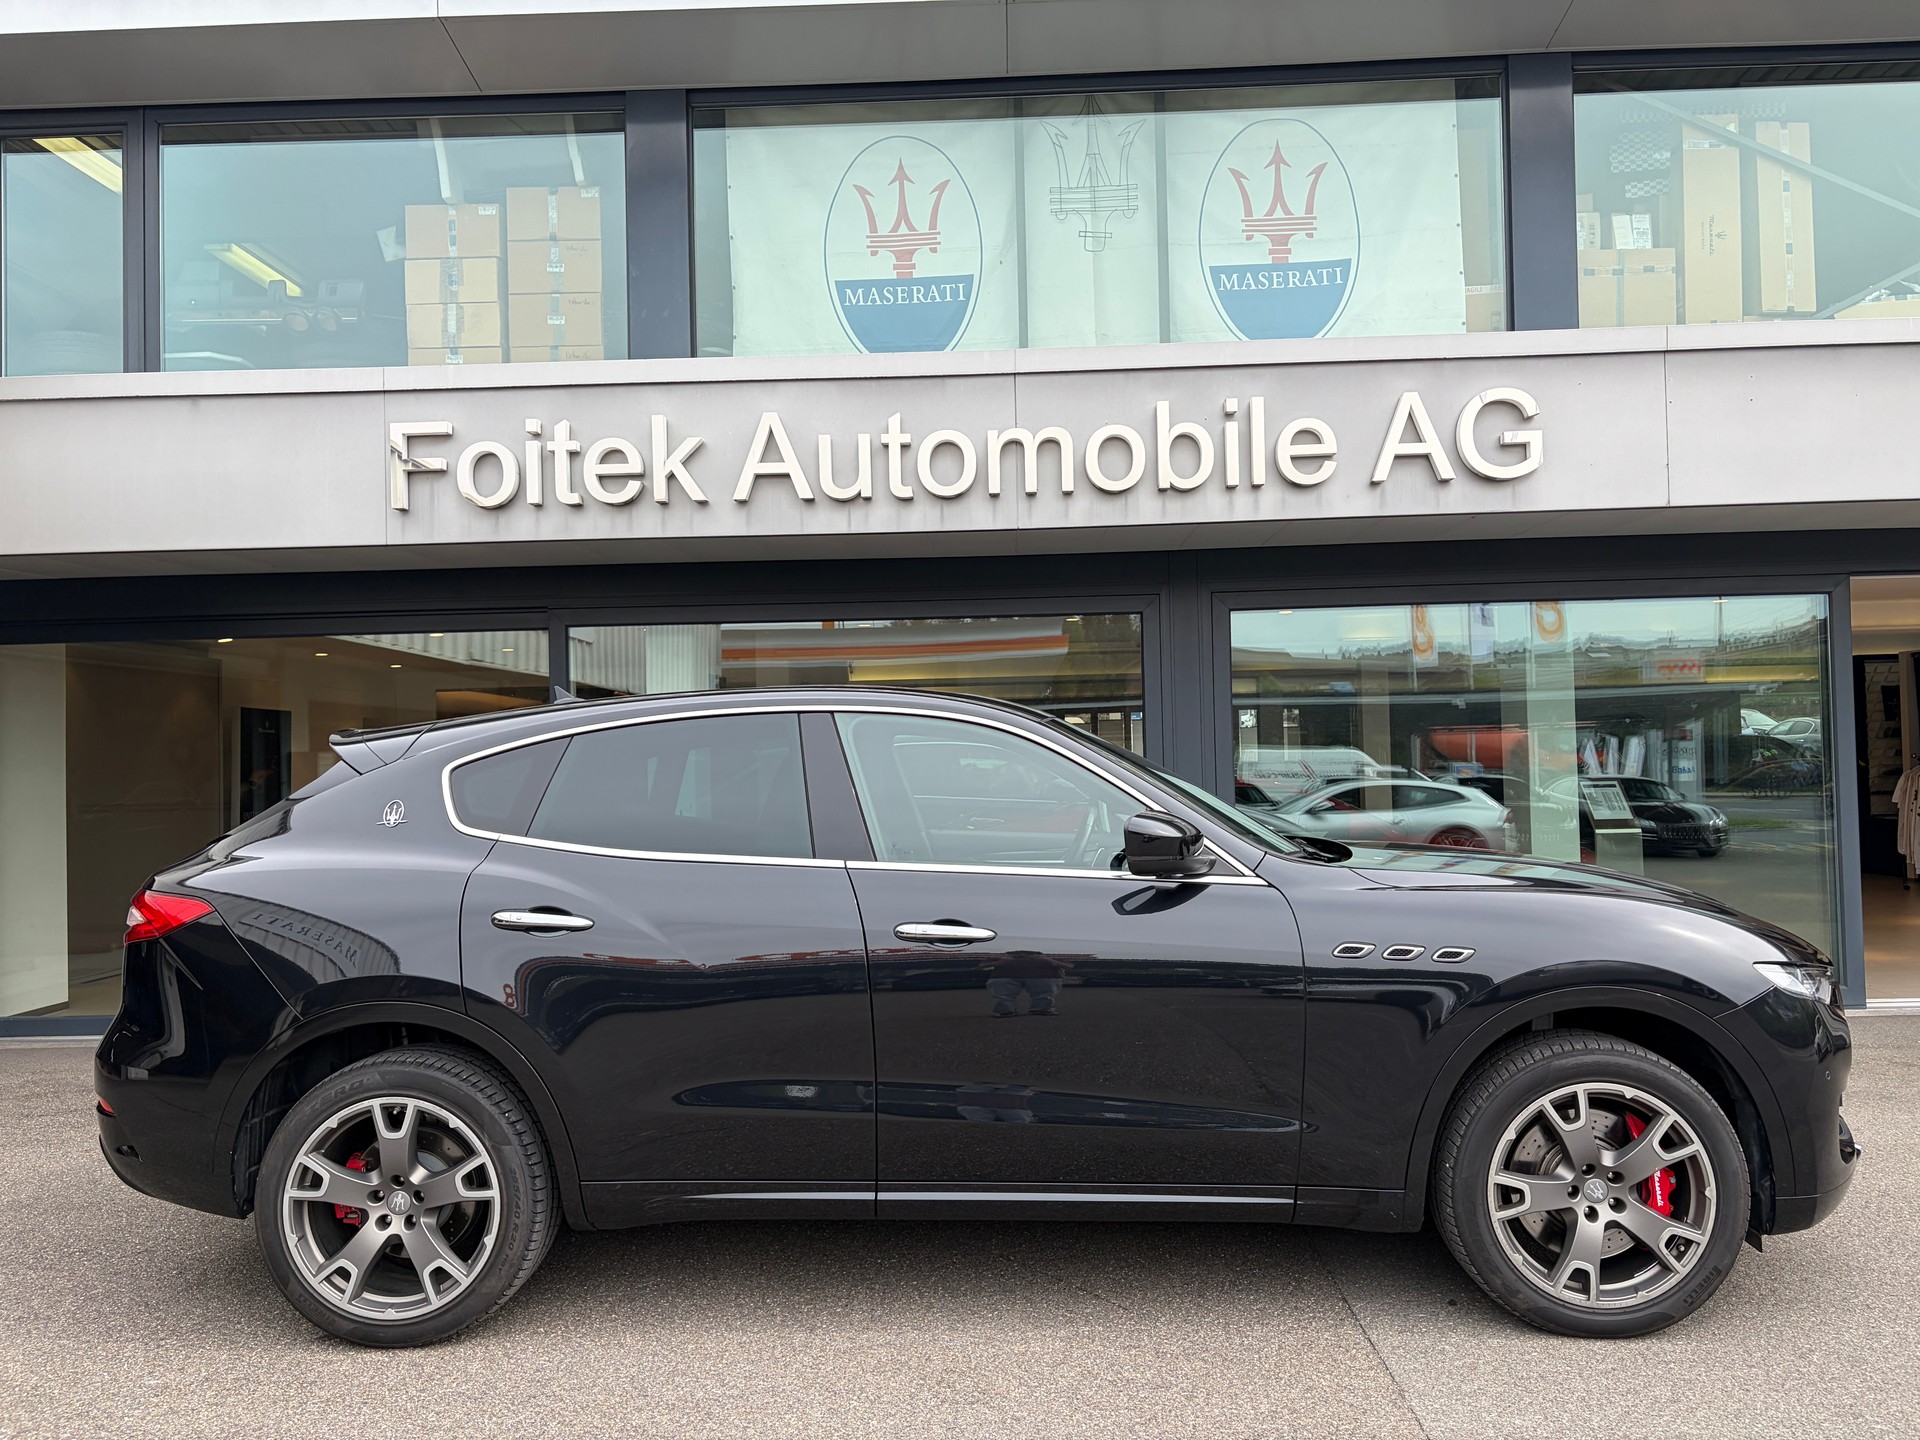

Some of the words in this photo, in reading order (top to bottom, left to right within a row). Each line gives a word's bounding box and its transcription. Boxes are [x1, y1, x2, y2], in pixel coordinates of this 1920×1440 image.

[844, 282, 967, 307] MASERATI
[1218, 267, 1344, 291] MASERATI
[389, 414, 710, 511] Foitek
[733, 396, 1338, 502] Automobile
[1370, 387, 1544, 485] AG
[1682, 1264, 1722, 1307] PIRELLI
